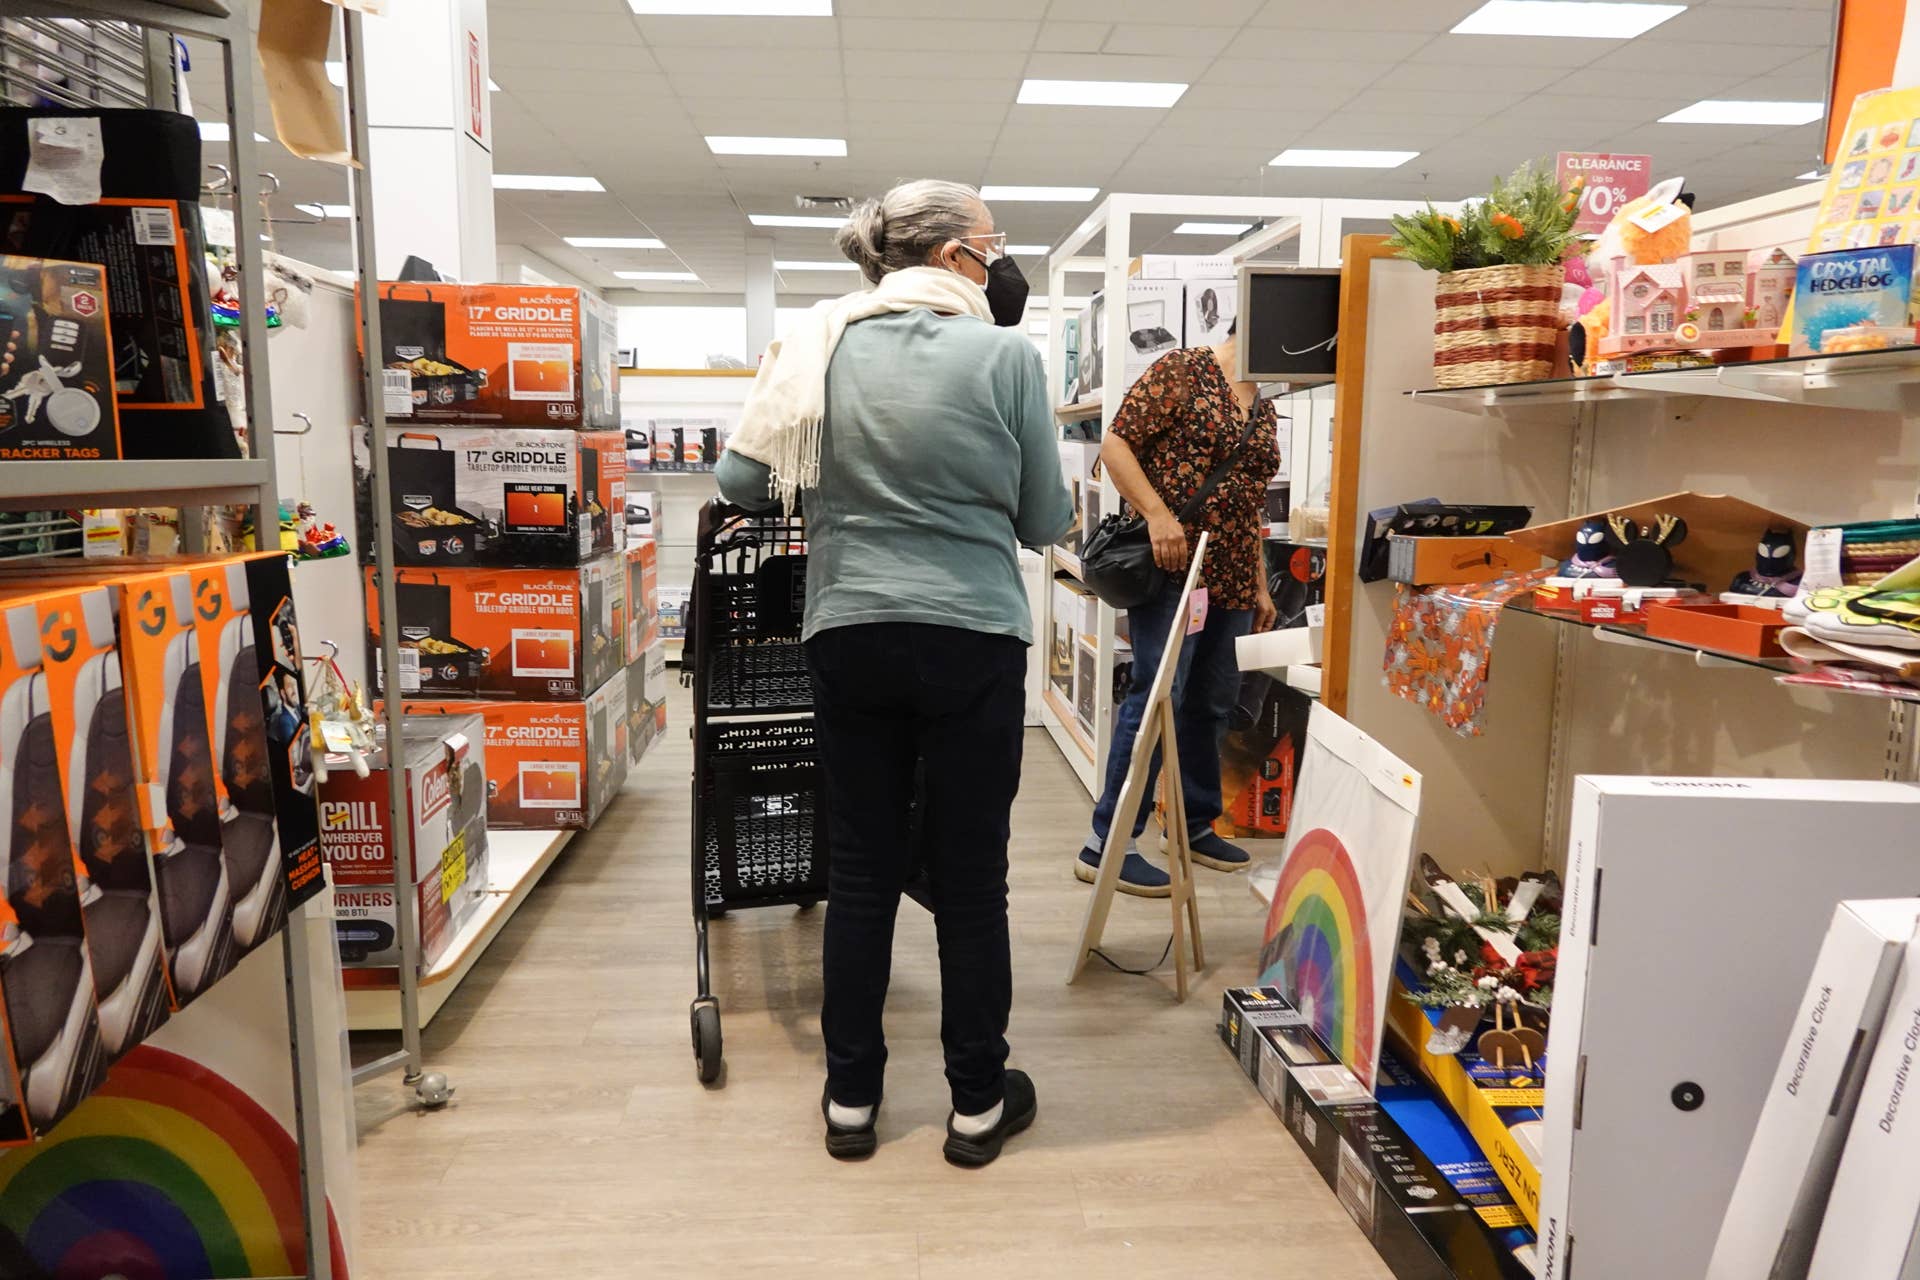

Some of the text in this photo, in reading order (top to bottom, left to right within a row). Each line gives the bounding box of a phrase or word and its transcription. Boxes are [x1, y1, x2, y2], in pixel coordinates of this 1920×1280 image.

[1566, 158, 1643, 171] CLEARANCE
[1605, 175, 1614, 183] to
[1811, 257, 1891, 279] CRYSTAL
[1810, 273, 1893, 293] HEDGEHOG
[520, 296, 572, 305] BLACKSTONE
[468, 305, 573, 322] 17" GRIDDLE
[0, 447, 101, 459] RACKER TAGS
[466, 450, 567, 465] 17" GRIDDLE
[467, 463, 500, 473] TABLETOP
[502, 464, 529, 473] GRIDDLE
[531, 465, 548, 473] WITH
[533, 504, 539, 513] 1
[523, 583, 574, 591] BLACKSTONE
[474, 592, 574, 607] 17" GRIDDLE
[475, 605, 508, 614] TABLETOP
[508, 605, 536, 614] GRIDDLE
[537, 606, 555, 614] WITH
[530, 716, 580, 724] BLACKSTONE
[506, 726, 580, 739] GRIDDLE
[516, 739, 543, 747] GRIDDLE
[544, 739, 561, 747] WITH
[423, 771, 451, 810] Colem
[1649, 781, 1752, 789] SONOMA
[1247, 783, 1256, 828] BONUS
[320, 801, 383, 831] GRILL
[321, 832, 383, 844] WHEREVER
[322, 845, 358, 861] YOU
[360, 845, 385, 861] GO
[288, 853, 319, 881] MASSAGE
[291, 866, 321, 891] CUSHION
[351, 908, 369, 917] BTU
[1241, 999, 1281, 1007] eclipse
[1786, 985, 1833, 1097] Decorative Clock
[1878, 1008, 1920, 1134] Decorative Clock
[1444, 1166, 1495, 1176] BLACKOU
[1523, 1177, 1540, 1215] UN
[1544, 1216, 1557, 1280] ONOMA
